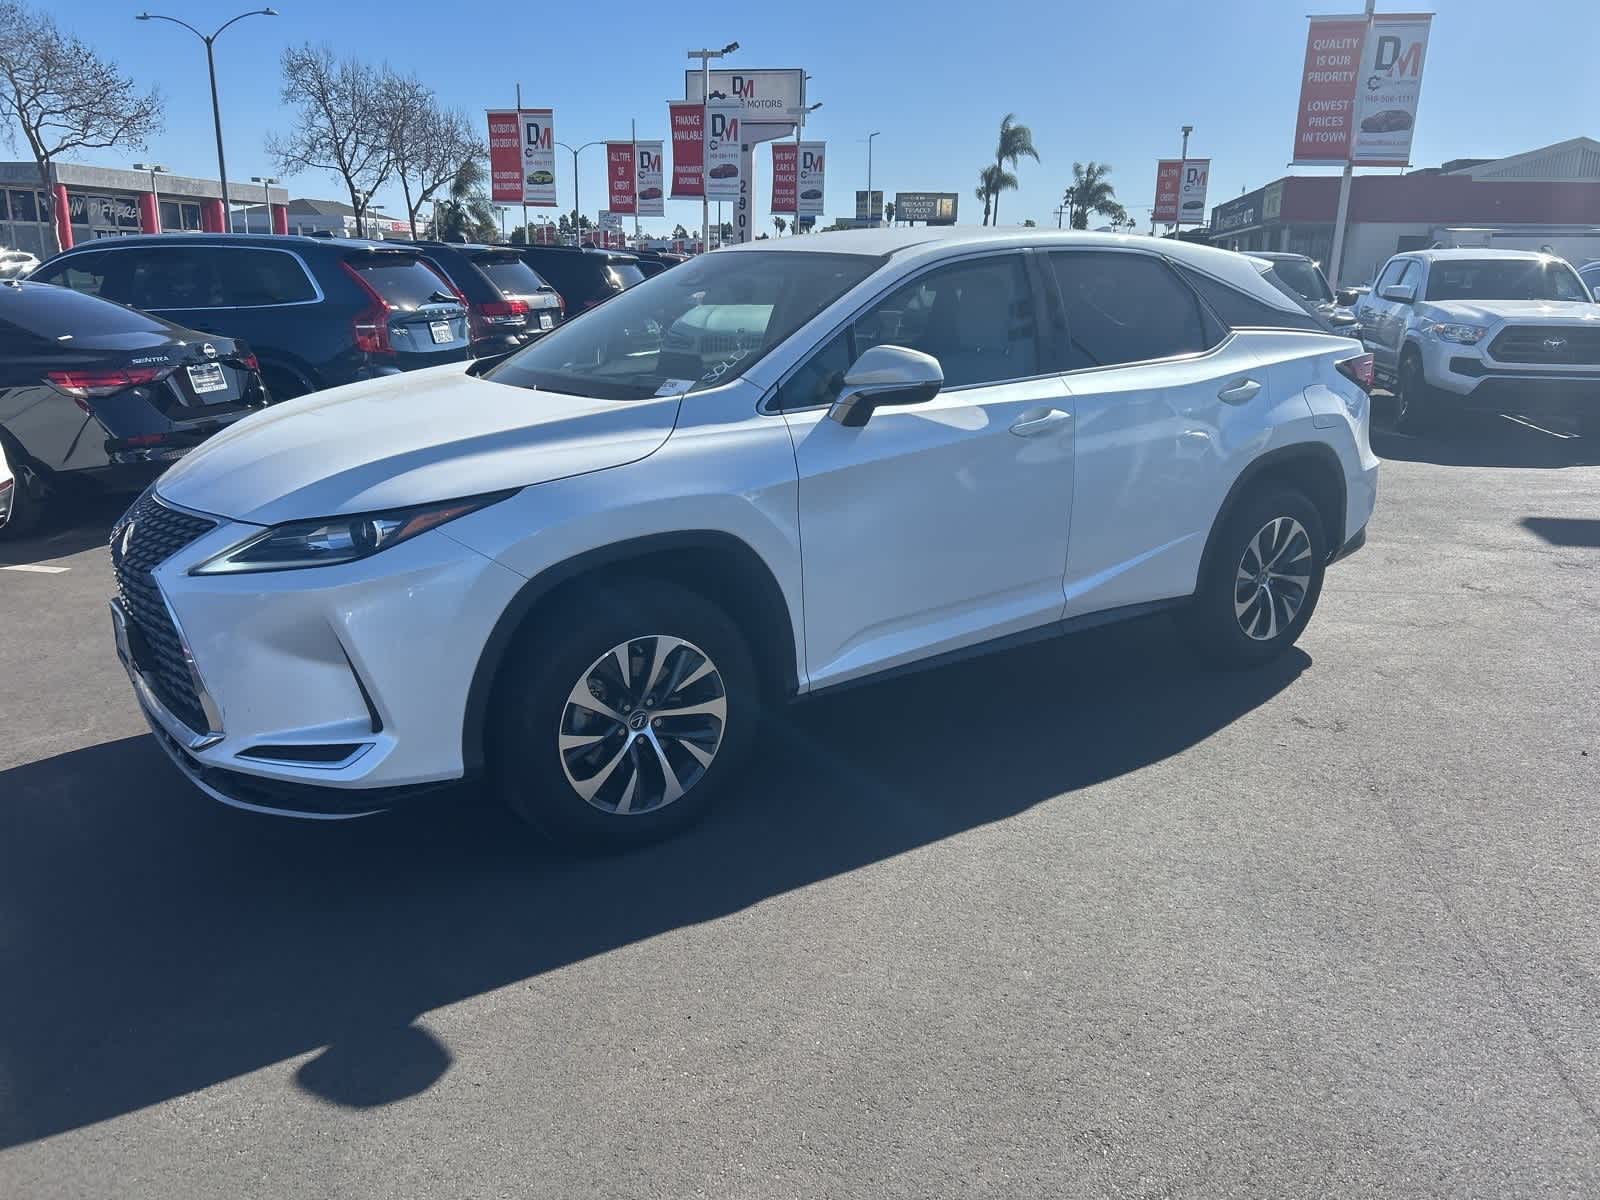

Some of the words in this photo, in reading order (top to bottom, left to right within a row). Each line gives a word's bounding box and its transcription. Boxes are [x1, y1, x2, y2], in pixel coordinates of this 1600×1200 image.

[1312, 38, 1360, 50] QUALITY
[1316, 55, 1326, 66] IS
[1327, 55, 1352, 66] OUR
[1375, 35, 1422, 77] DM
[1308, 71, 1356, 83] PRIORITY
[747, 100, 783, 109] MOTORS
[1307, 99, 1349, 111] LOWEST
[675, 115, 701, 125] FINANCE
[1308, 116, 1345, 127] PRICES
[673, 131, 703, 141] AVAILABLE
[1302, 132, 1314, 143] IN
[1314, 132, 1346, 143] TOWN
[775, 163, 789, 171] CARS
[775, 174, 796, 182] TRUCKS
[132, 356, 169, 364] SENTRA
